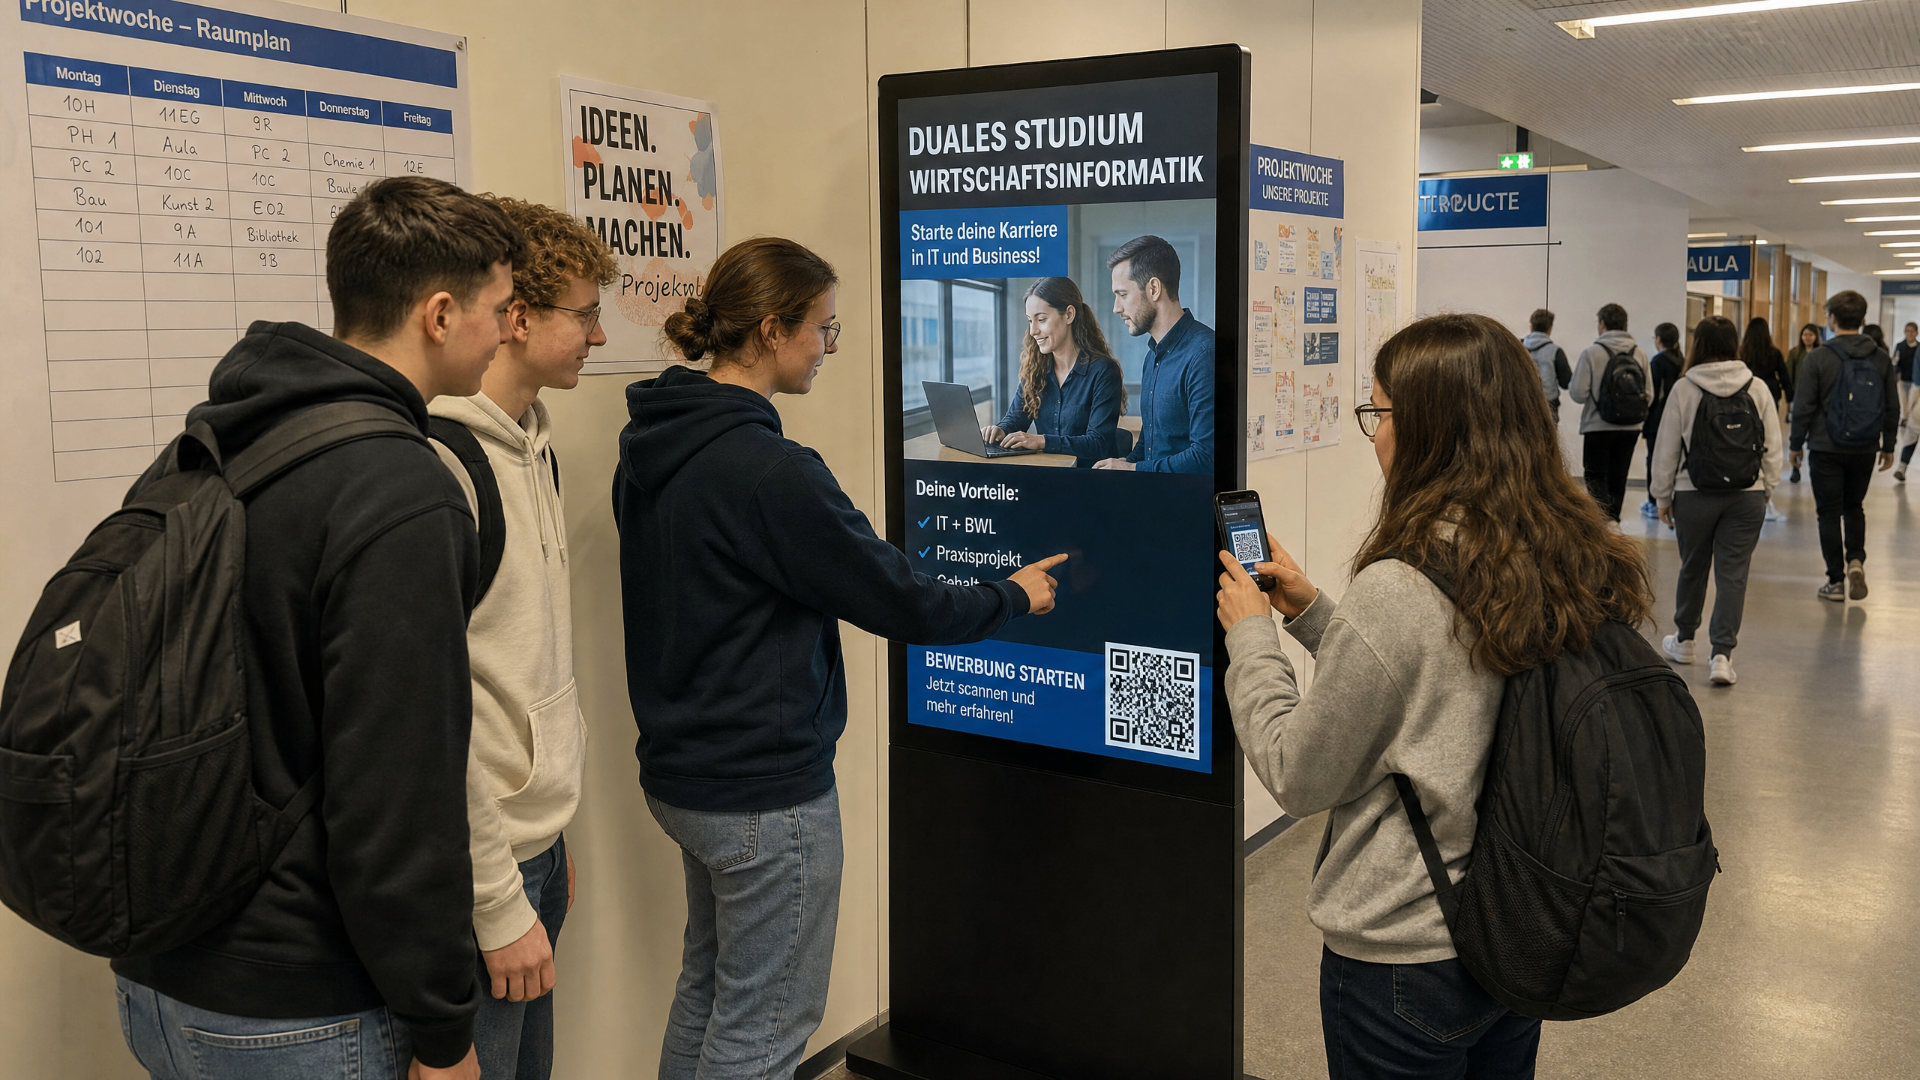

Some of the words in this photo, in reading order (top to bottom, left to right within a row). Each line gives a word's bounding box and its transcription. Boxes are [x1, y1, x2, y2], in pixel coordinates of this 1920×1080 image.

[196, 18, 291, 53] Raumplan
[56, 66, 102, 87] Montag
[153, 79, 200, 99] Dienstag
[243, 91, 288, 108] Mittwoch
[319, 101, 370, 120] Donnerstag
[403, 111, 432, 127] Freitag
[67, 126, 94, 145] PH
[108, 131, 117, 150] 1
[580, 105, 657, 153] IDEEN.
[909, 121, 1007, 156] DUALES
[1014, 111, 1144, 151] STUDIUM
[162, 137, 198, 156] Aula
[252, 145, 270, 160] PC
[282, 148, 291, 163] 2
[70, 157, 91, 174] PC
[105, 160, 115, 177] 2
[323, 151, 365, 171] Chemie
[369, 157, 375, 171] 1
[403, 160, 423, 174] 12E
[1257, 156, 1333, 186] PROJEKTWOCHE
[165, 165, 192, 182] 10C
[252, 172, 276, 187] 10C
[909, 155, 1205, 195] WIRTSCHAFTSINFORMATIK
[583, 161, 681, 208] PLANEN.
[73, 187, 108, 208] Bau
[162, 194, 199, 211] Kunst
[205, 197, 214, 213] 2
[1263, 184, 1292, 202] UNSERE
[1294, 189, 1329, 206] PROJEKTE
[75, 218, 103, 235] 101
[247, 226, 299, 244] Bibliothek
[911, 223, 954, 242] Starte
[957, 221, 996, 240] deine
[999, 220, 1058, 239] Karriere
[586, 216, 691, 259] MACHEN.
[76, 247, 104, 265] 102
[259, 253, 278, 268] 9B
[911, 249, 924, 266] in
[927, 249, 939, 265] IT
[943, 247, 968, 265] und
[972, 246, 1040, 265] Business!
[1687, 255, 1739, 273] AULA
[916, 480, 955, 498] Deine
[959, 482, 1019, 502] Vorteile:
[936, 516, 948, 531] IT
[952, 520, 961, 530] +
[965, 517, 997, 535] BWL
[936, 545, 1022, 570] Praxisprojekt
[925, 651, 1016, 681] BEWERBUNG
[1019, 665, 1085, 690] STARTEN
[926, 676, 955, 694] Jetzt
[958, 681, 1008, 702] scannen
[1012, 689, 1035, 706] und
[926, 698, 957, 715] mehr
[960, 703, 1014, 724] erfahren!
